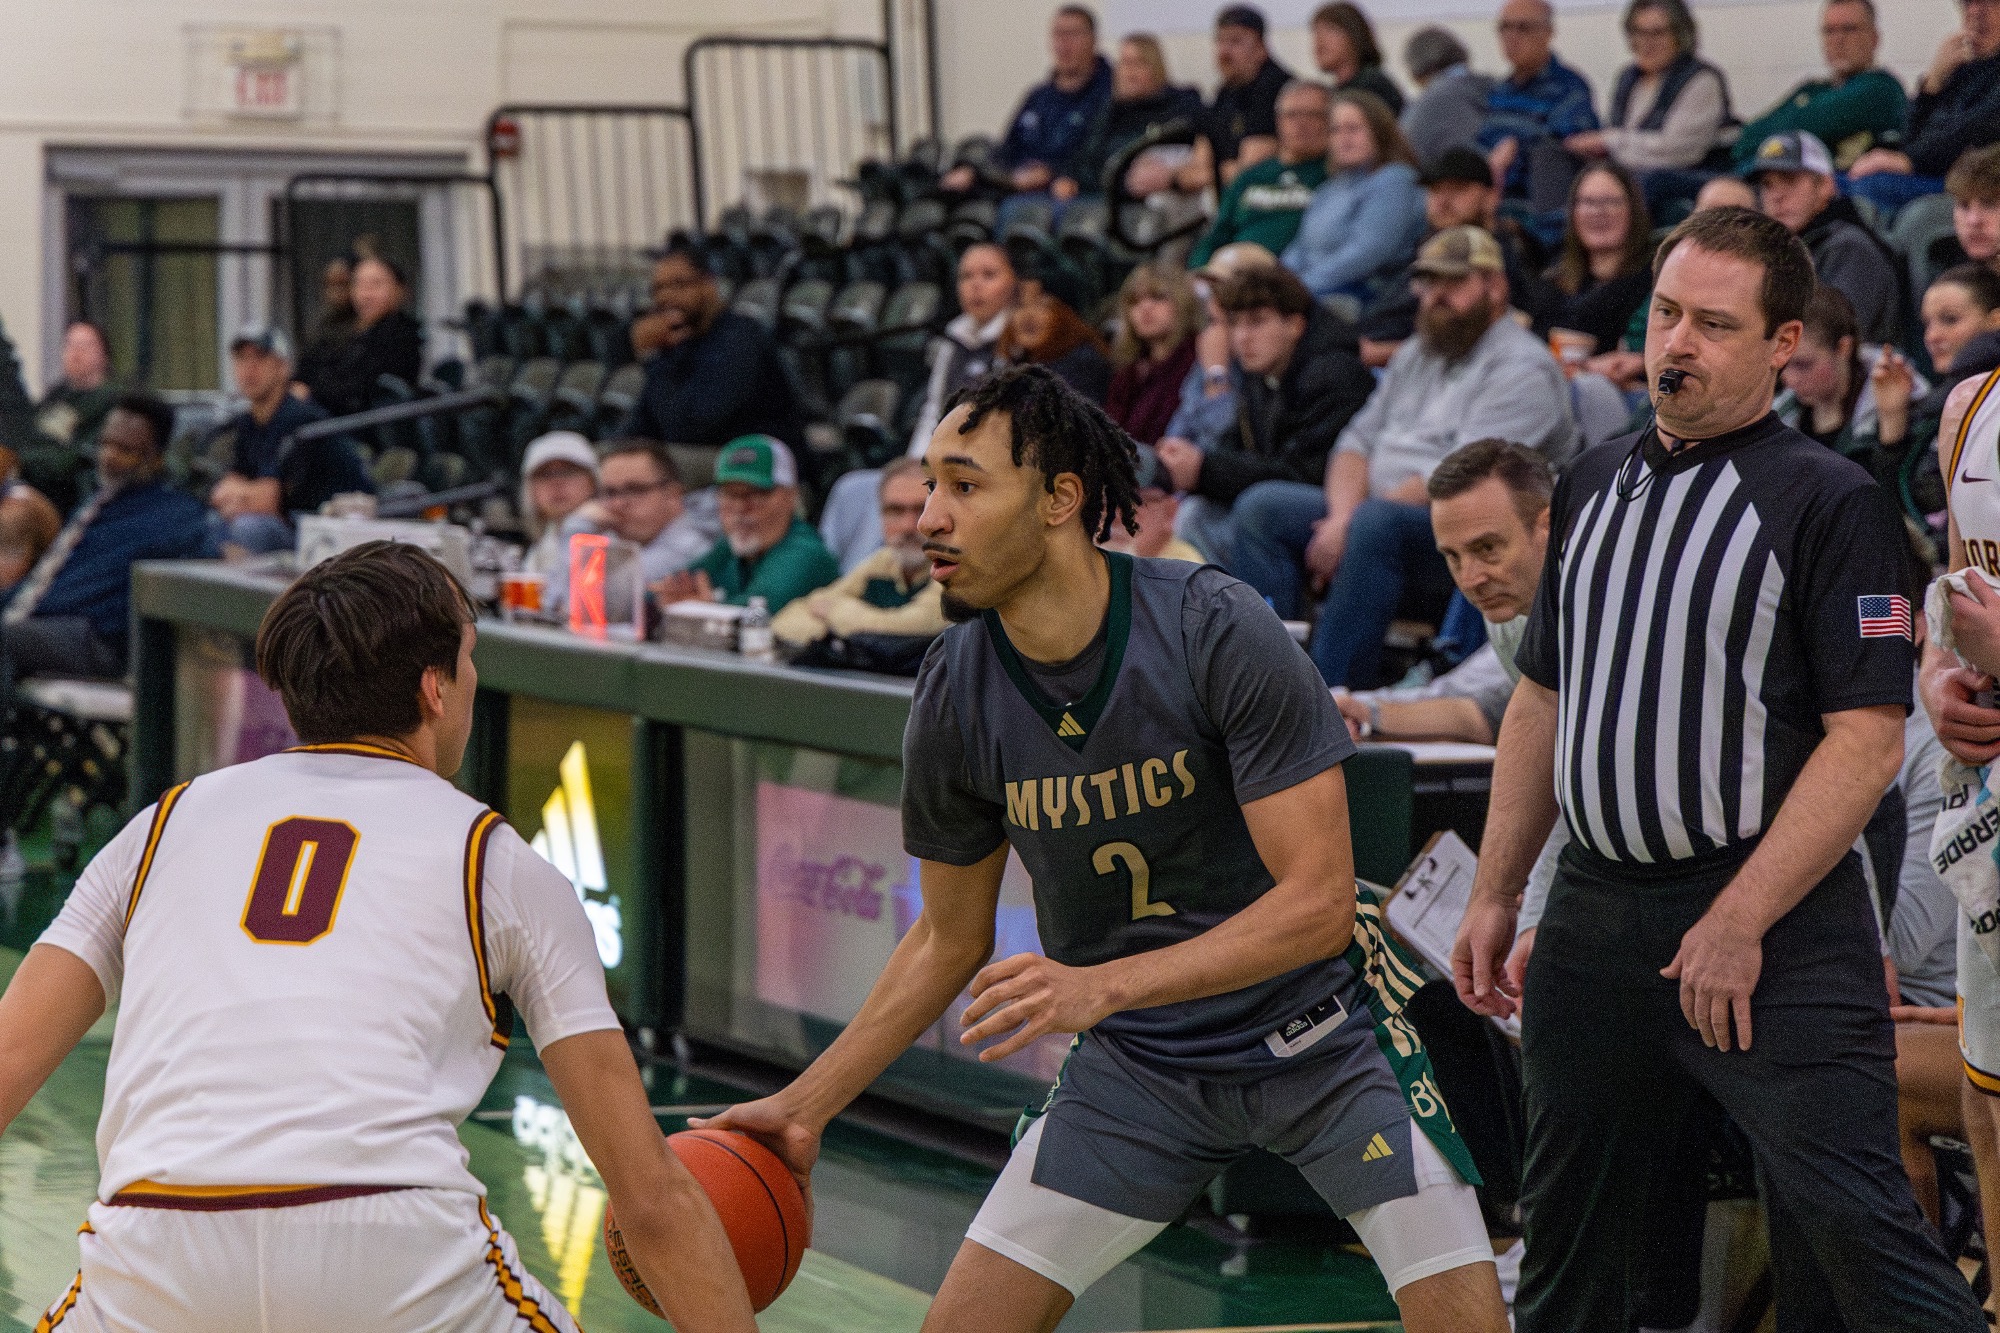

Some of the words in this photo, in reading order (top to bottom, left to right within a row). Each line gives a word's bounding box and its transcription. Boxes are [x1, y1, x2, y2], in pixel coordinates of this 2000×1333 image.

[1005, 749, 1196, 831] MYSTICS
[239, 814, 362, 947] 0
[1092, 841, 1176, 920] 2
[1933, 806, 2000, 875] ERADE
[1285, 1021, 1308, 1037] adidas
[612, 1217, 659, 1309] EGAC
